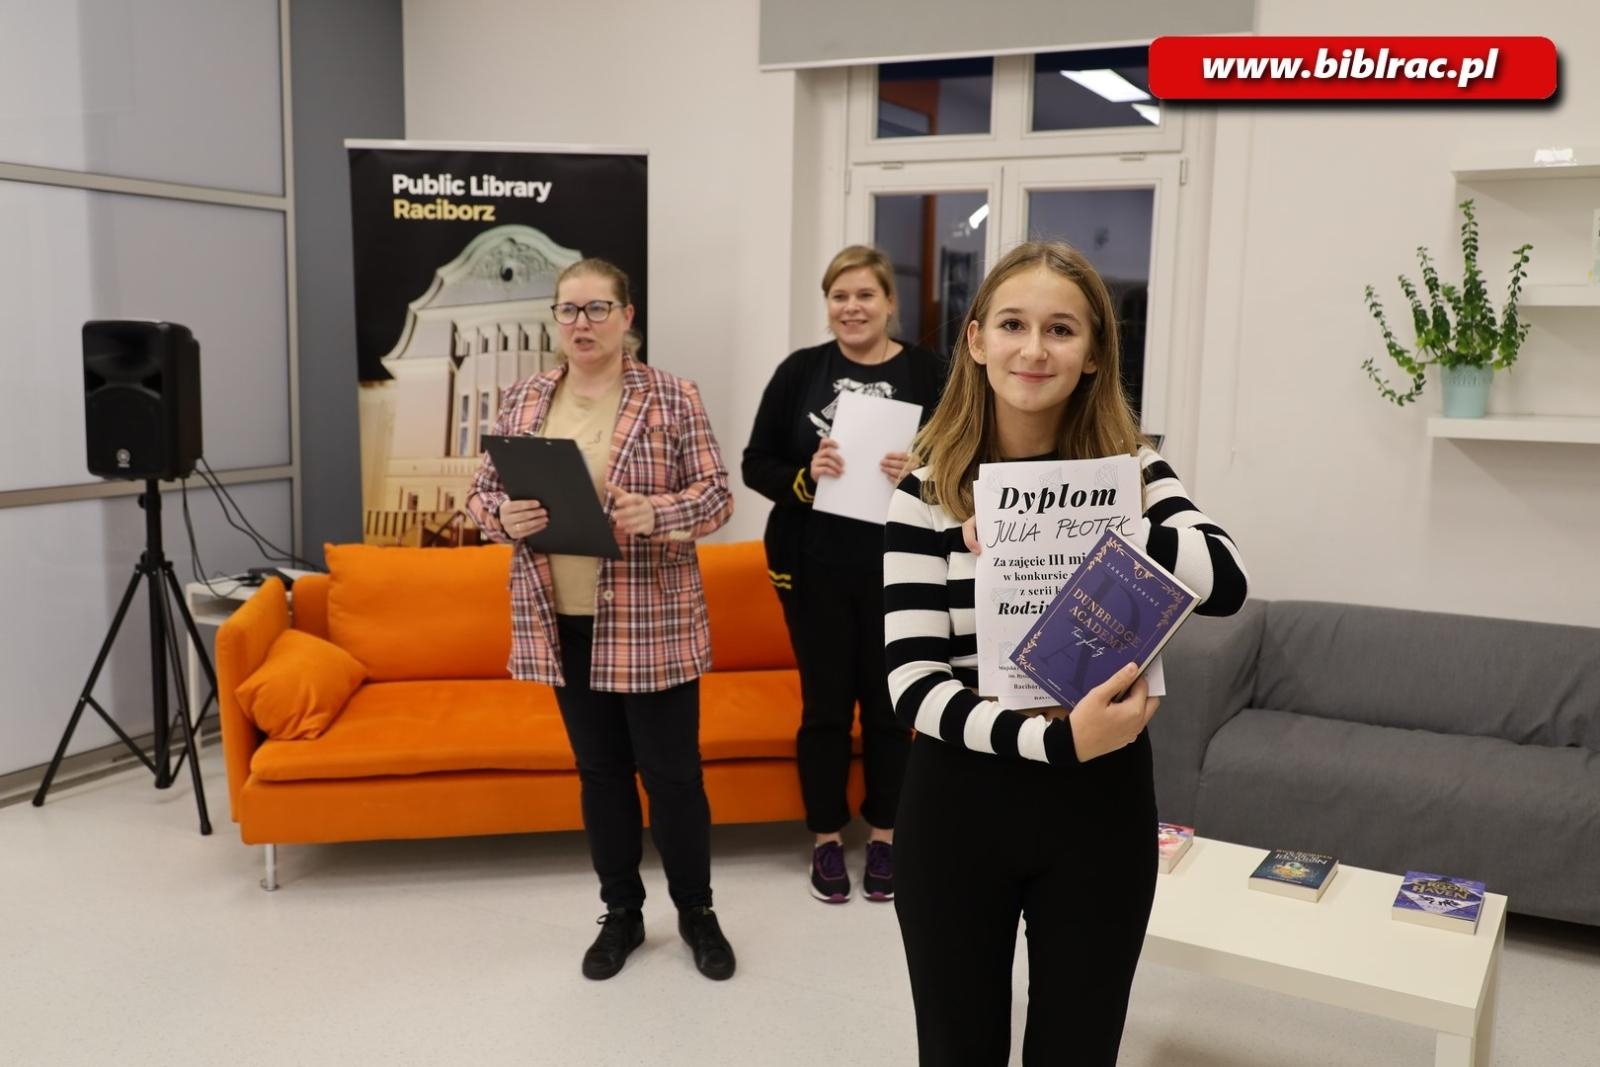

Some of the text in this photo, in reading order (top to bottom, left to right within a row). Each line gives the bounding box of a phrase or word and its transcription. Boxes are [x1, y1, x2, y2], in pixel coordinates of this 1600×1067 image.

[392, 173, 552, 203] Public Library
[393, 198, 495, 221] Raciborz
[998, 483, 1117, 514] Dyplom
[986, 518, 1041, 549] JULIA
[993, 557, 1006, 567] Za
[1008, 556, 1046, 568] zajęcie
[1048, 554, 1065, 566] III
[1014, 571, 1069, 581] konkursie
[1028, 586, 1052, 595] serii
[998, 601, 1050, 615] Rodzi
[1073, 588, 1140, 648] DUNBRIDGE
[1068, 605, 1129, 652] ACADEMY
